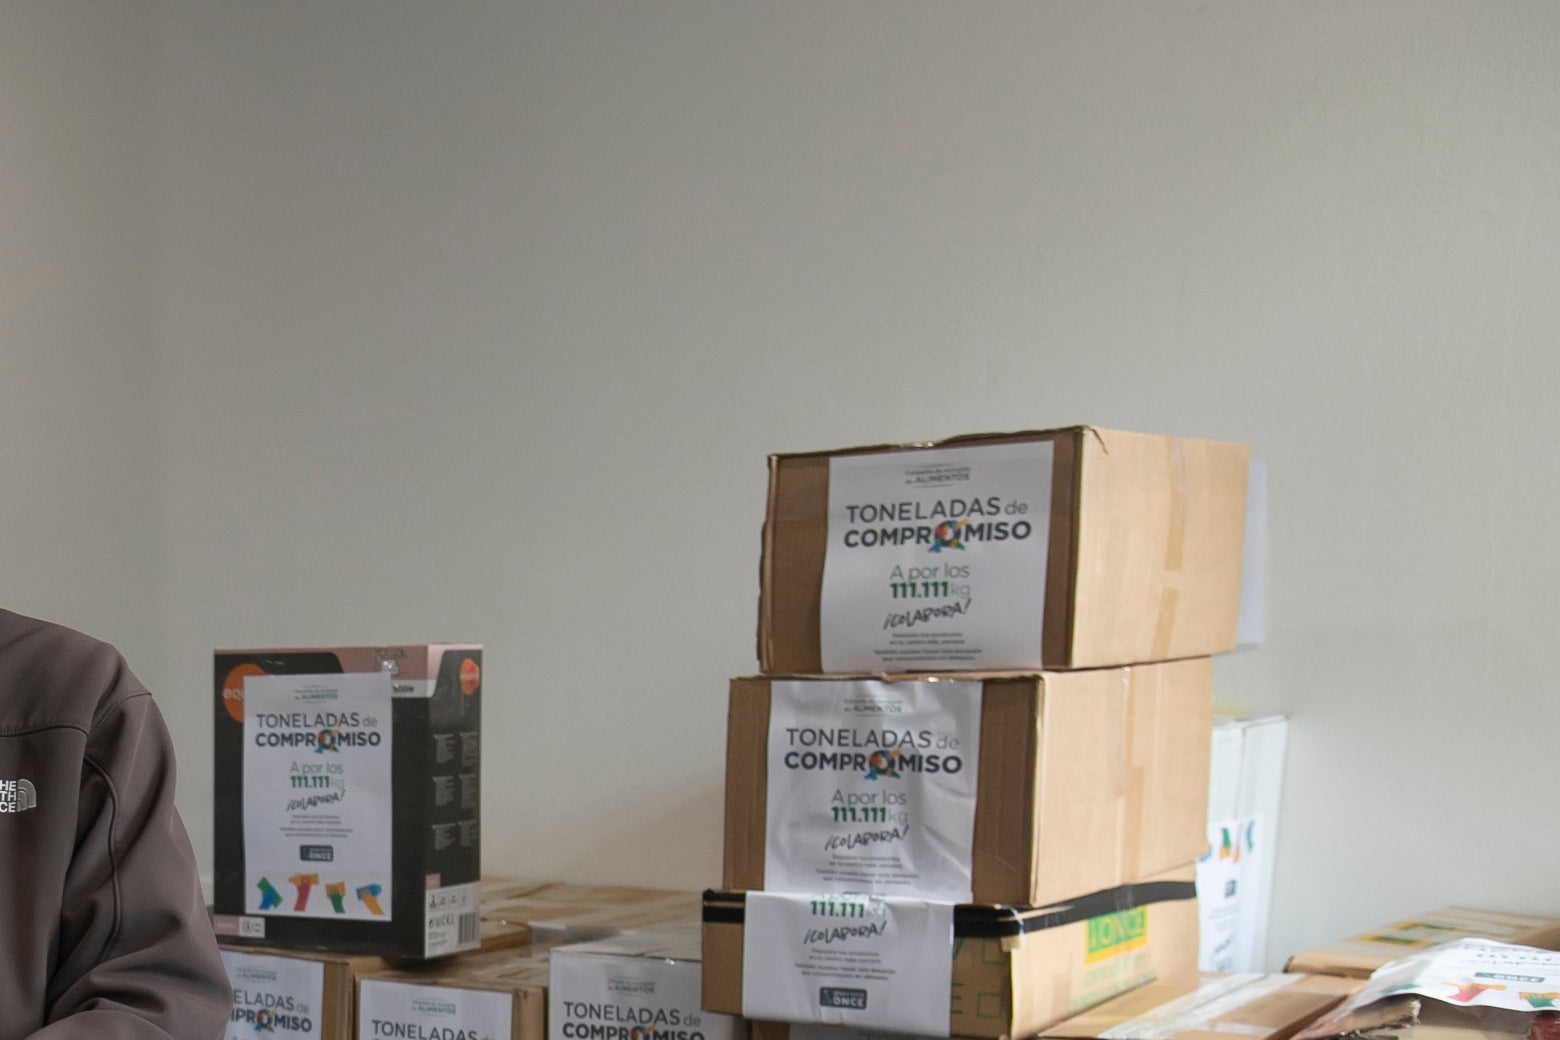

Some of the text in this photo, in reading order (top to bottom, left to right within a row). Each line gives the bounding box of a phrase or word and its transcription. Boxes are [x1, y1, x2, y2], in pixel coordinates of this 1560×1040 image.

[845, 497, 1029, 523] TONELADAS de
[844, 521, 1032, 549] COMPROMISO
[890, 562, 970, 582] A por los
[890, 581, 949, 598] 111.111
[256, 713, 378, 728] TONELADAS de
[255, 730, 381, 749] COMPROMISO
[786, 728, 960, 749] TONELADAS de
[291, 762, 344, 776] A por los
[785, 750, 962, 776] COMPROMISO
[290, 776, 330, 788] 111.111
[831, 788, 907, 806] A por los
[831, 806, 886, 823] 111.111
[811, 901, 865, 918] 111.111
[233, 989, 295, 1011] ELADAS
[231, 1008, 312, 1032] PROMISO
[564, 1002, 701, 1027] TONELADAS de
